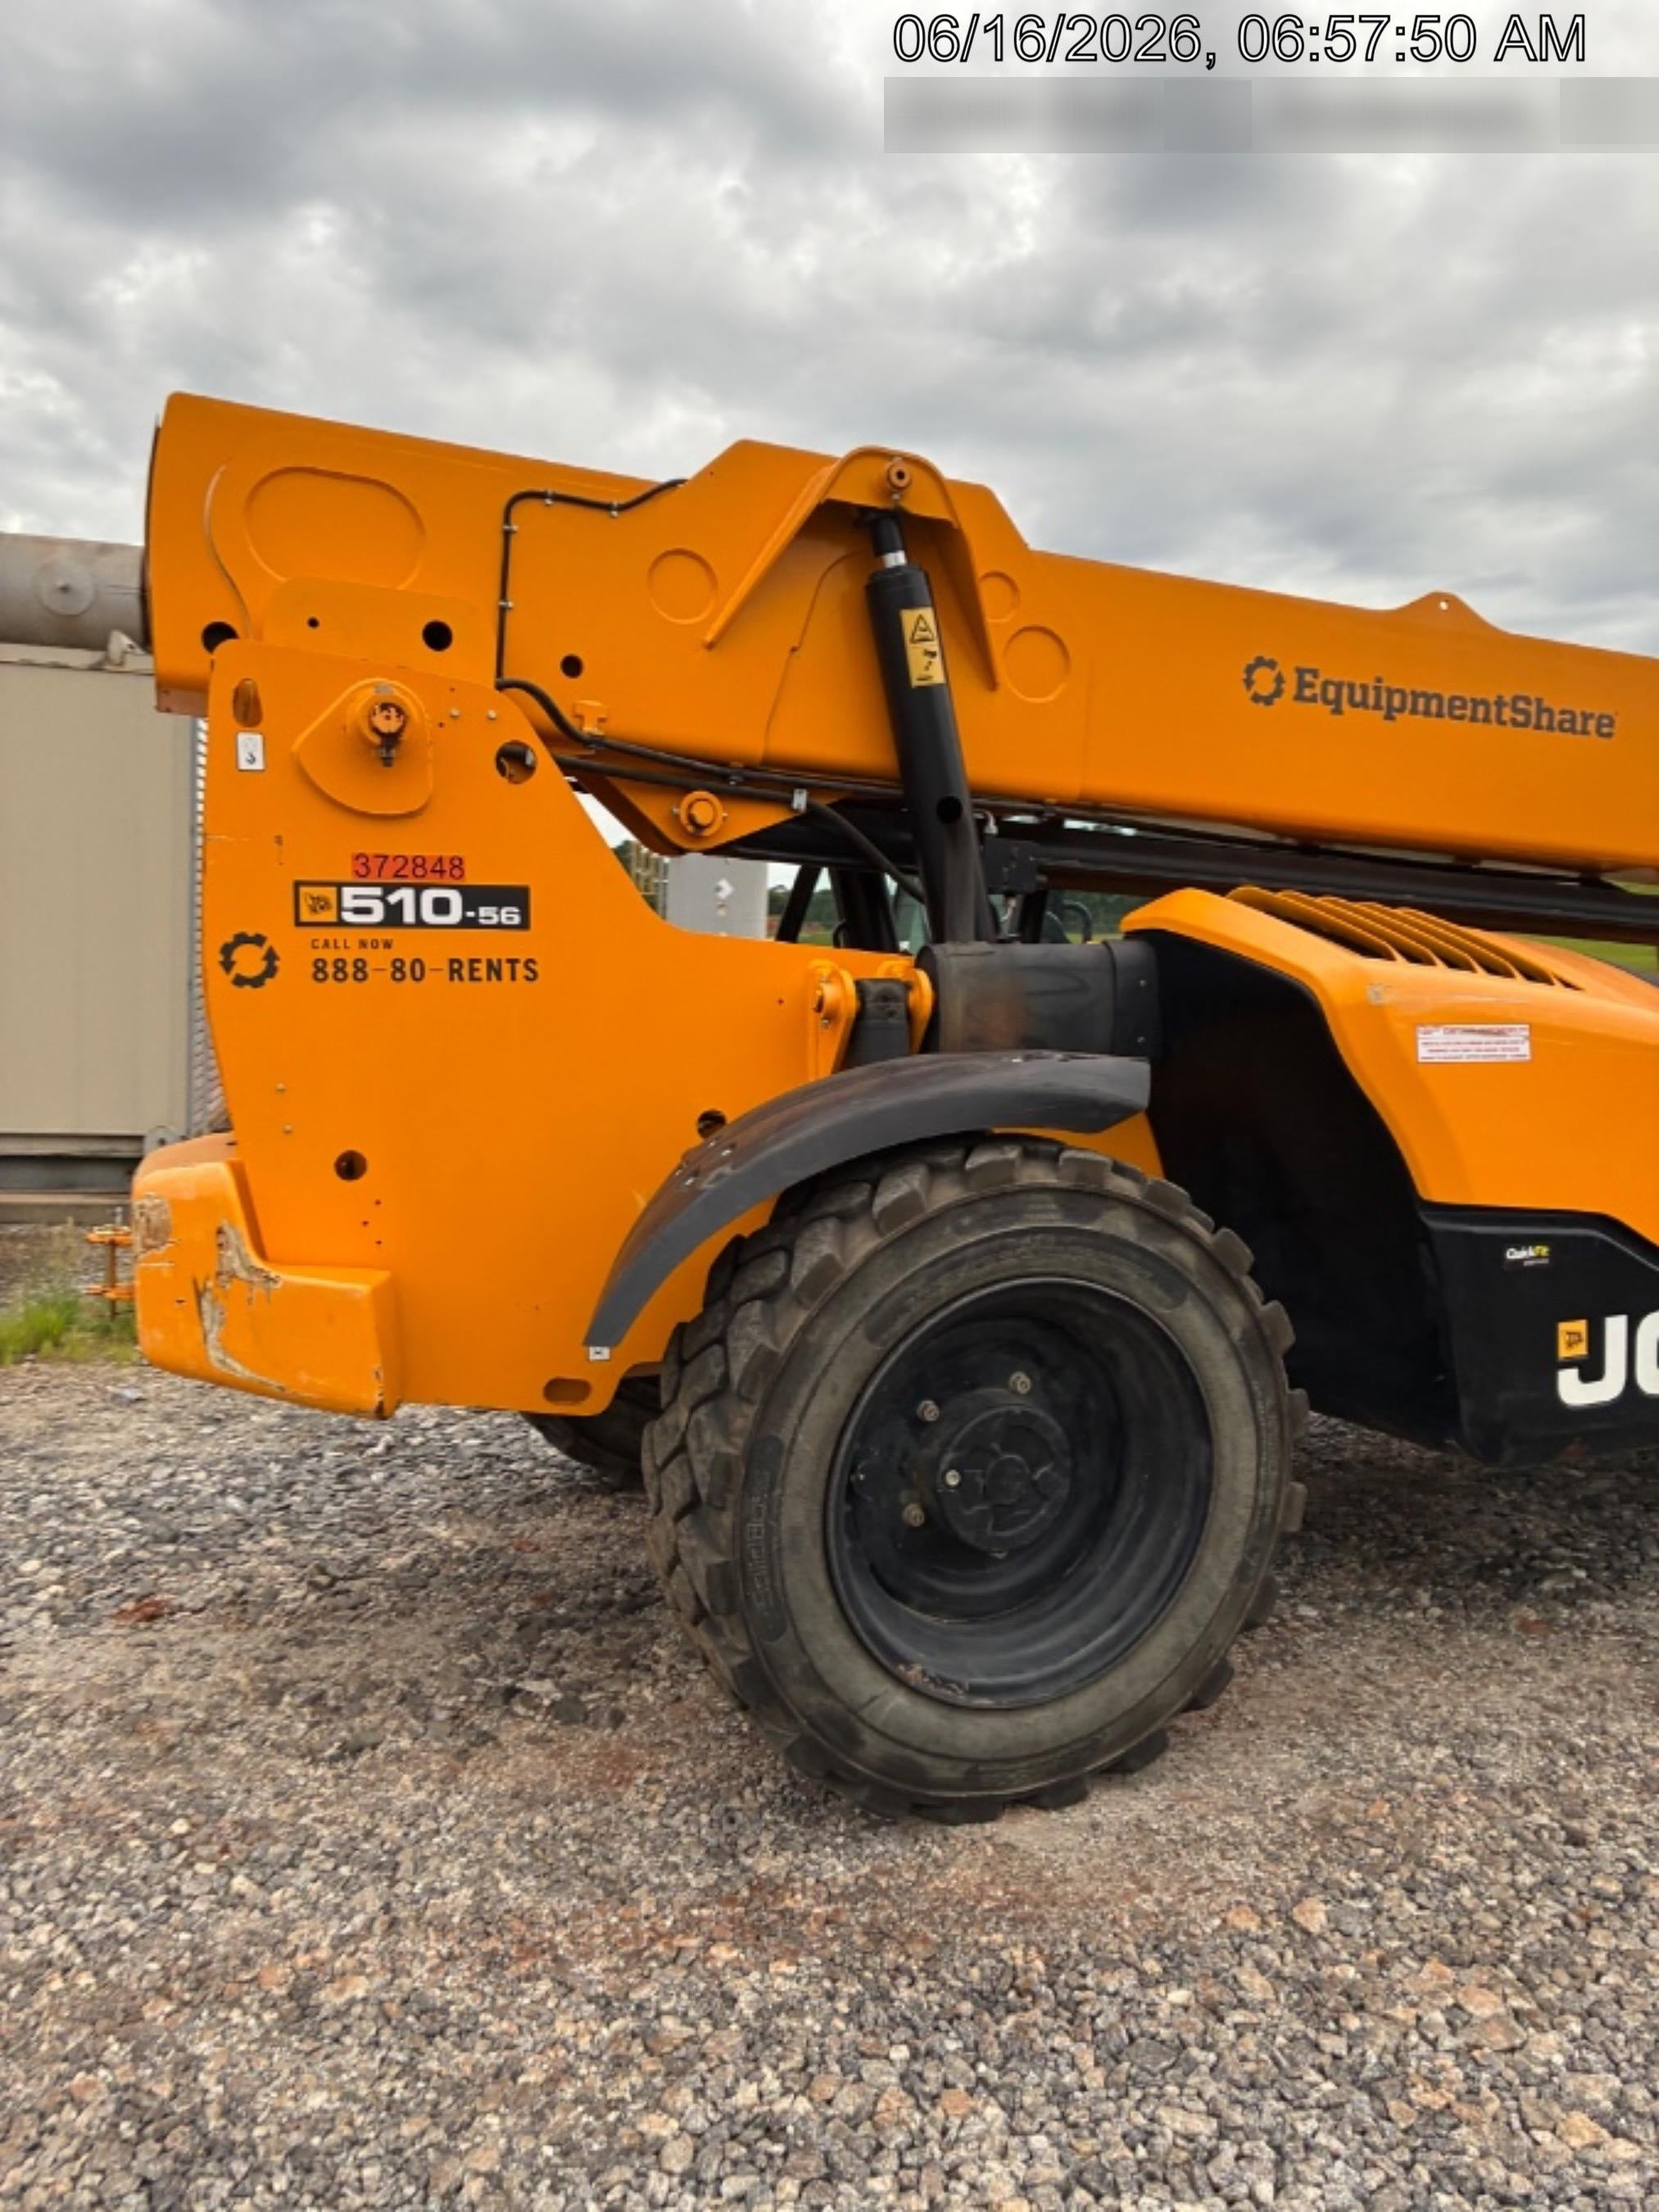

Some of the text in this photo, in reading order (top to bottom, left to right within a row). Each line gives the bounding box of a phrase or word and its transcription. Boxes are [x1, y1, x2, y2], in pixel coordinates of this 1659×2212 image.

[1293, 665, 1615, 738] EquipmentShare
[354, 853, 465, 880] 372848
[341, 886, 521, 926] 510-56
[311, 938, 393, 950] CALL NOW
